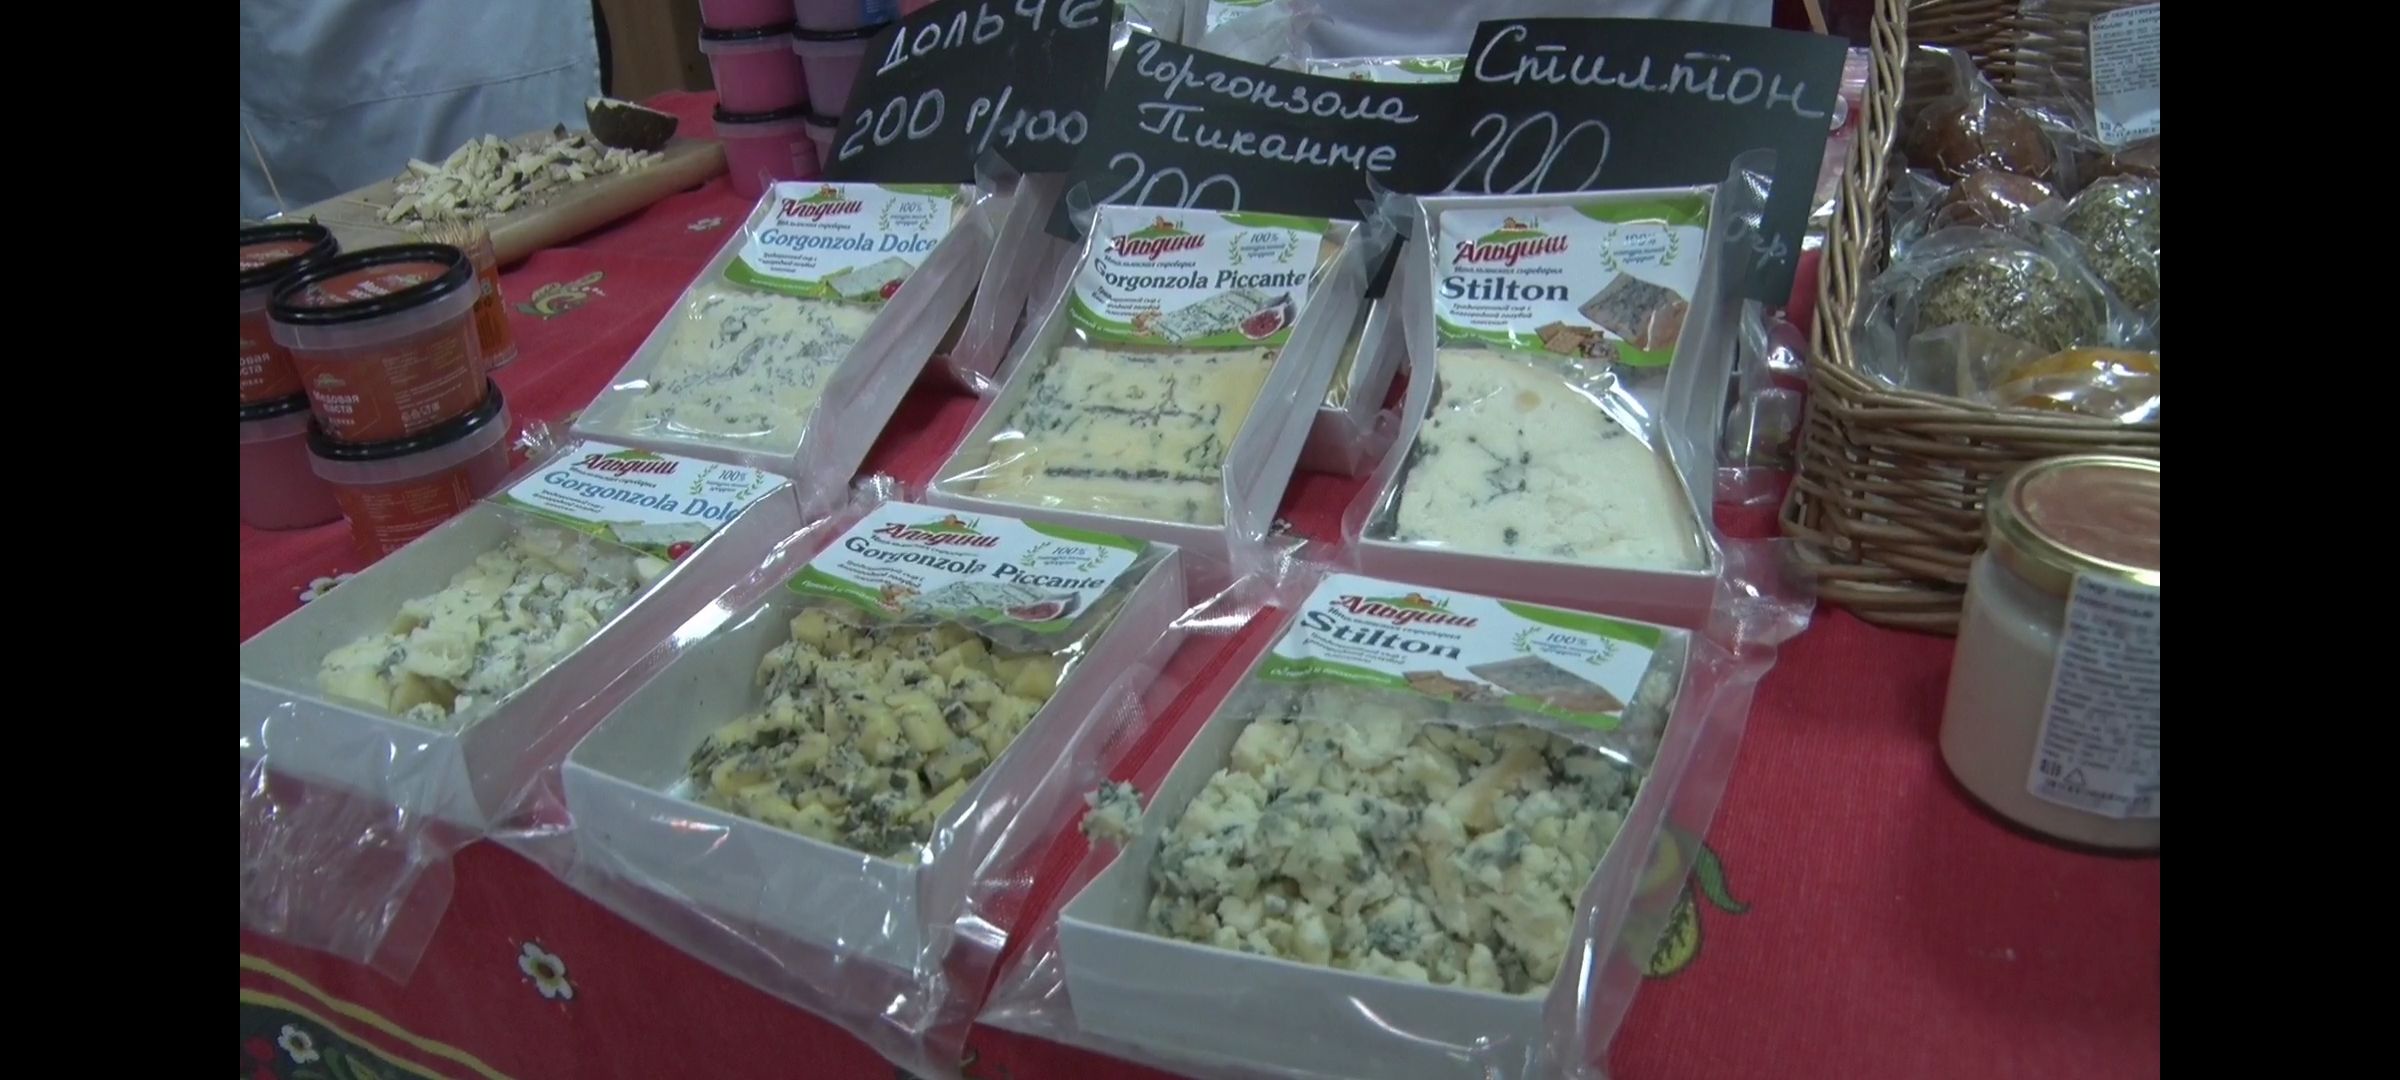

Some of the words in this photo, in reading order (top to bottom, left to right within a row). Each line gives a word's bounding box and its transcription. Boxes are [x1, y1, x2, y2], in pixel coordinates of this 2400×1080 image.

[1137, 39, 1419, 123] Горгонзола
[1475, 24, 1824, 118] Стилтон
[838, 88, 945, 161] 200
[1138, 102, 1397, 171] Пиканте
[1443, 110, 1610, 193] 200
[1101, 152, 1241, 211] 200
[775, 197, 863, 222] Альдини
[760, 229, 874, 252] Gorgonzola
[878, 231, 938, 254] Dolce
[1104, 232, 1206, 261] Альдини
[1250, 231, 1279, 243] 100%
[1453, 234, 1569, 267] Альдини
[1094, 257, 1208, 292] Gorgonzola
[1214, 268, 1306, 289] Piccante
[1440, 275, 1569, 301] Stilton
[576, 452, 680, 477] Альдини
[718, 469, 747, 482] 100%
[544, 471, 680, 513] Gorgonzola
[873, 520, 1001, 547] Альдини
[844, 535, 987, 575] Gorgonzola
[991, 562, 1107, 590] Piccante
[1328, 593, 1480, 630] Альдини
[1299, 610, 1462, 662] Stilton
[1546, 632, 1588, 646] 100%
